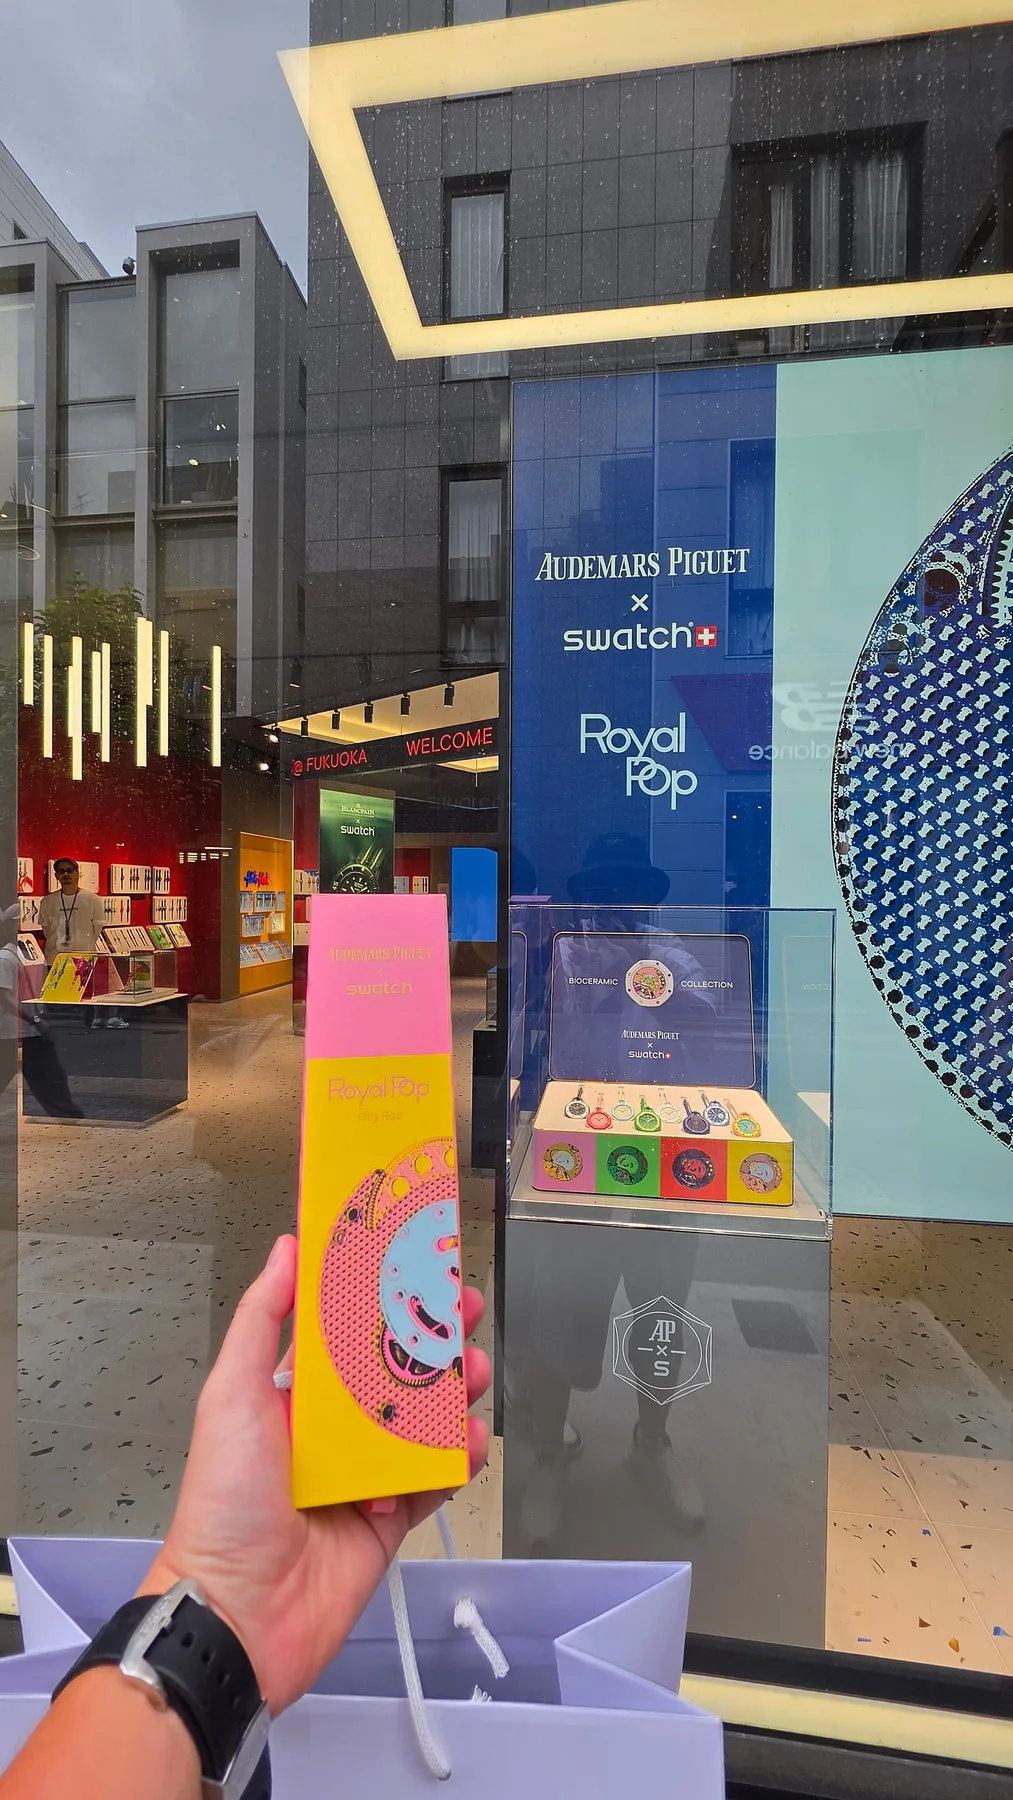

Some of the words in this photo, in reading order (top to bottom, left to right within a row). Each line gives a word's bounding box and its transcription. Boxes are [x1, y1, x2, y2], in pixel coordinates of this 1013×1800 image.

[535, 551, 660, 582] AUDEMARS
[667, 546, 750, 577] PIGUET
[405, 726, 494, 757] WELCOME
[580, 711, 686, 758] Royal
[292, 760, 303, 777] @
[306, 748, 368, 773] FUKUOKA
[625, 756, 698, 810] Pop
[340, 825, 375, 837] swatch
[326, 946, 390, 962] AUDEMARS
[393, 944, 433, 961] PIGUET
[346, 980, 413, 996] swatch
[568, 976, 619, 987] BIOCERAMIC
[680, 979, 734, 989] COLLECTION
[621, 1029, 656, 1040] AUDEMARS
[657, 1029, 680, 1041] PIGUET
[328, 1076, 388, 1108] Royal
[392, 1075, 430, 1104] Pop
[648, 1319, 676, 1343] AP
[653, 1360, 670, 1377] S
